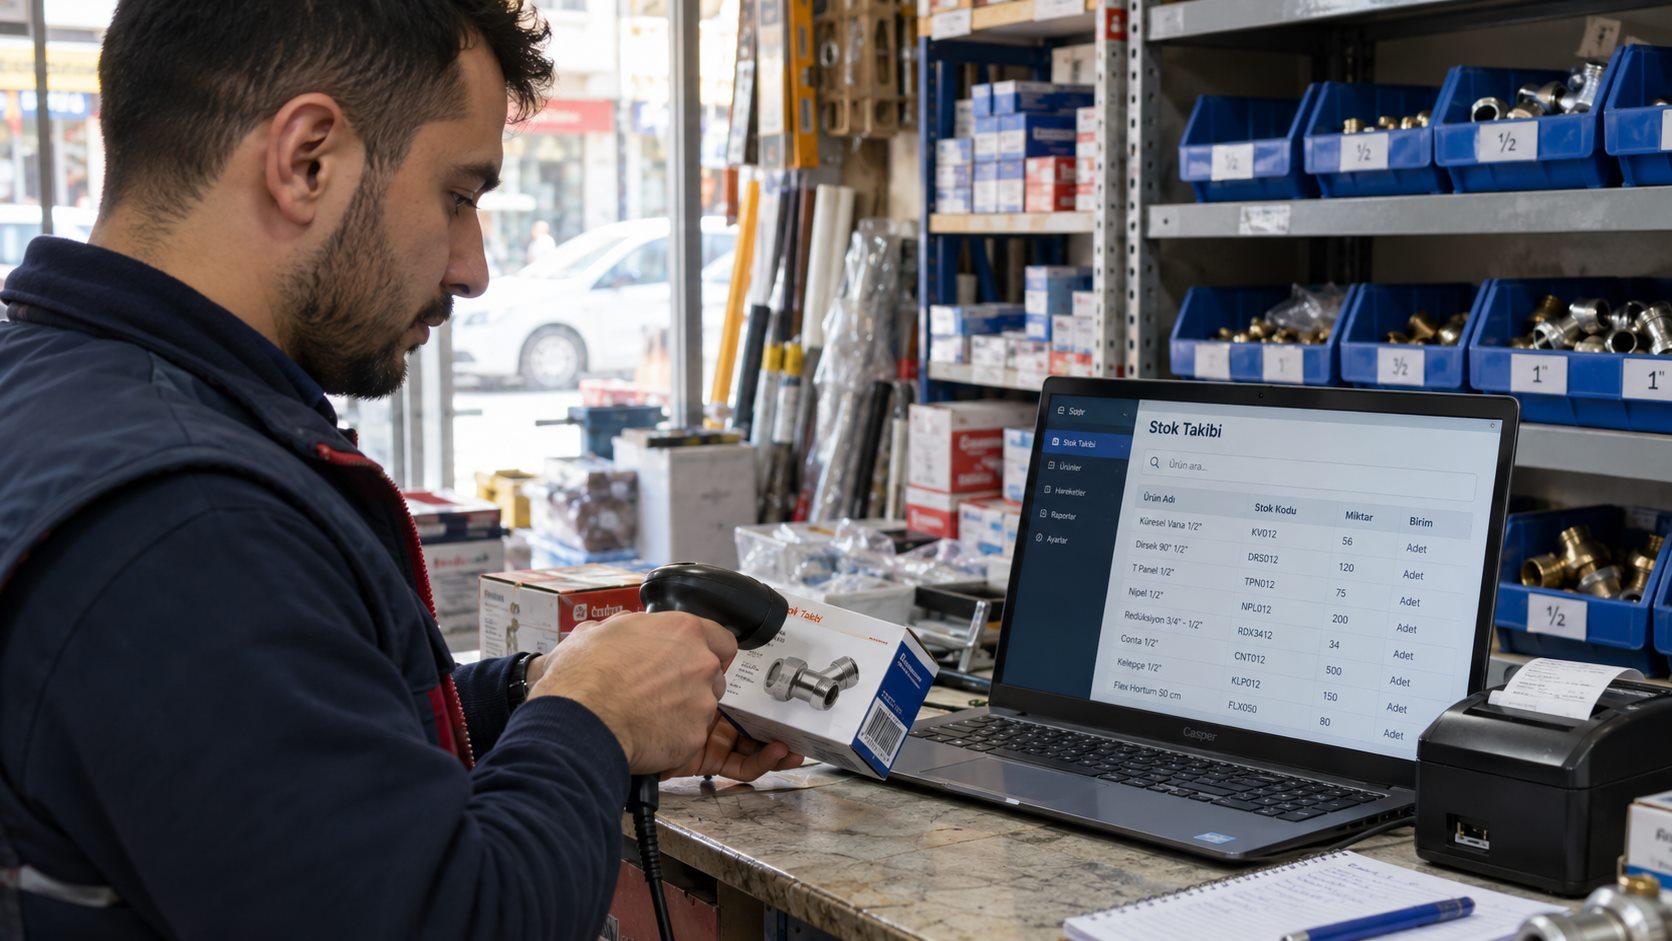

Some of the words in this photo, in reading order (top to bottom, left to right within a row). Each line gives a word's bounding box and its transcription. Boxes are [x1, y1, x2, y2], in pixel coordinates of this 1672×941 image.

[1647, 371, 1665, 390] 1"
[1149, 420, 1179, 436] Stok
[1183, 422, 1223, 438] Takibi
[1063, 438, 1077, 448] Stok
[1169, 458, 1188, 469] Ürün
[1143, 491, 1162, 503] Ürün
[1162, 495, 1176, 504] Adı
[1254, 503, 1273, 513] Stok
[1275, 504, 1297, 515] Kodu
[1345, 511, 1374, 522] Miktar
[1139, 516, 1166, 528] Küresel
[1167, 519, 1186, 529] Vana
[1409, 517, 1433, 528] Birim
[1251, 528, 1277, 539] KV012
[1046, 535, 1068, 545] Ayarlar
[1135, 539, 1158, 550] Dirsek
[1342, 536, 1353, 546] 56
[1406, 543, 1427, 554] Adet
[1248, 552, 1279, 564] DRS012
[1132, 563, 1138, 572] T
[1138, 564, 1158, 574] Panel
[1339, 562, 1355, 573] 120
[1402, 570, 1424, 580] Adet
[1244, 577, 1275, 589] TPN012
[1128, 587, 1148, 598] Nipel
[1335, 588, 1347, 598] 75
[1399, 596, 1421, 607] Adet
[1241, 602, 1272, 614] NPL012
[1124, 610, 1165, 624] Redüksiyon
[1332, 613, 1349, 624] 200
[1237, 626, 1273, 640] RDX3412
[1396, 623, 1417, 634] Adet
[1120, 634, 1142, 645] Conta
[1328, 639, 1340, 650] 34
[1234, 651, 1266, 664] CNT012
[1392, 650, 1414, 661] Adet
[1116, 657, 1145, 670] Kelepçe
[1325, 665, 1342, 676] 500
[1231, 676, 1261, 689] KLP012
[1389, 676, 1410, 687] Adet
[1113, 680, 1129, 691] Flex
[1129, 683, 1157, 697] Hortum
[1158, 688, 1169, 698] 50
[1169, 691, 1182, 700] cm
[1323, 691, 1338, 702] 150
[1228, 700, 1258, 714] FLX050
[1386, 702, 1408, 714] Adet
[1319, 716, 1331, 727] 80
[1182, 727, 1218, 742] Casper
[1383, 729, 1404, 741] Adet
